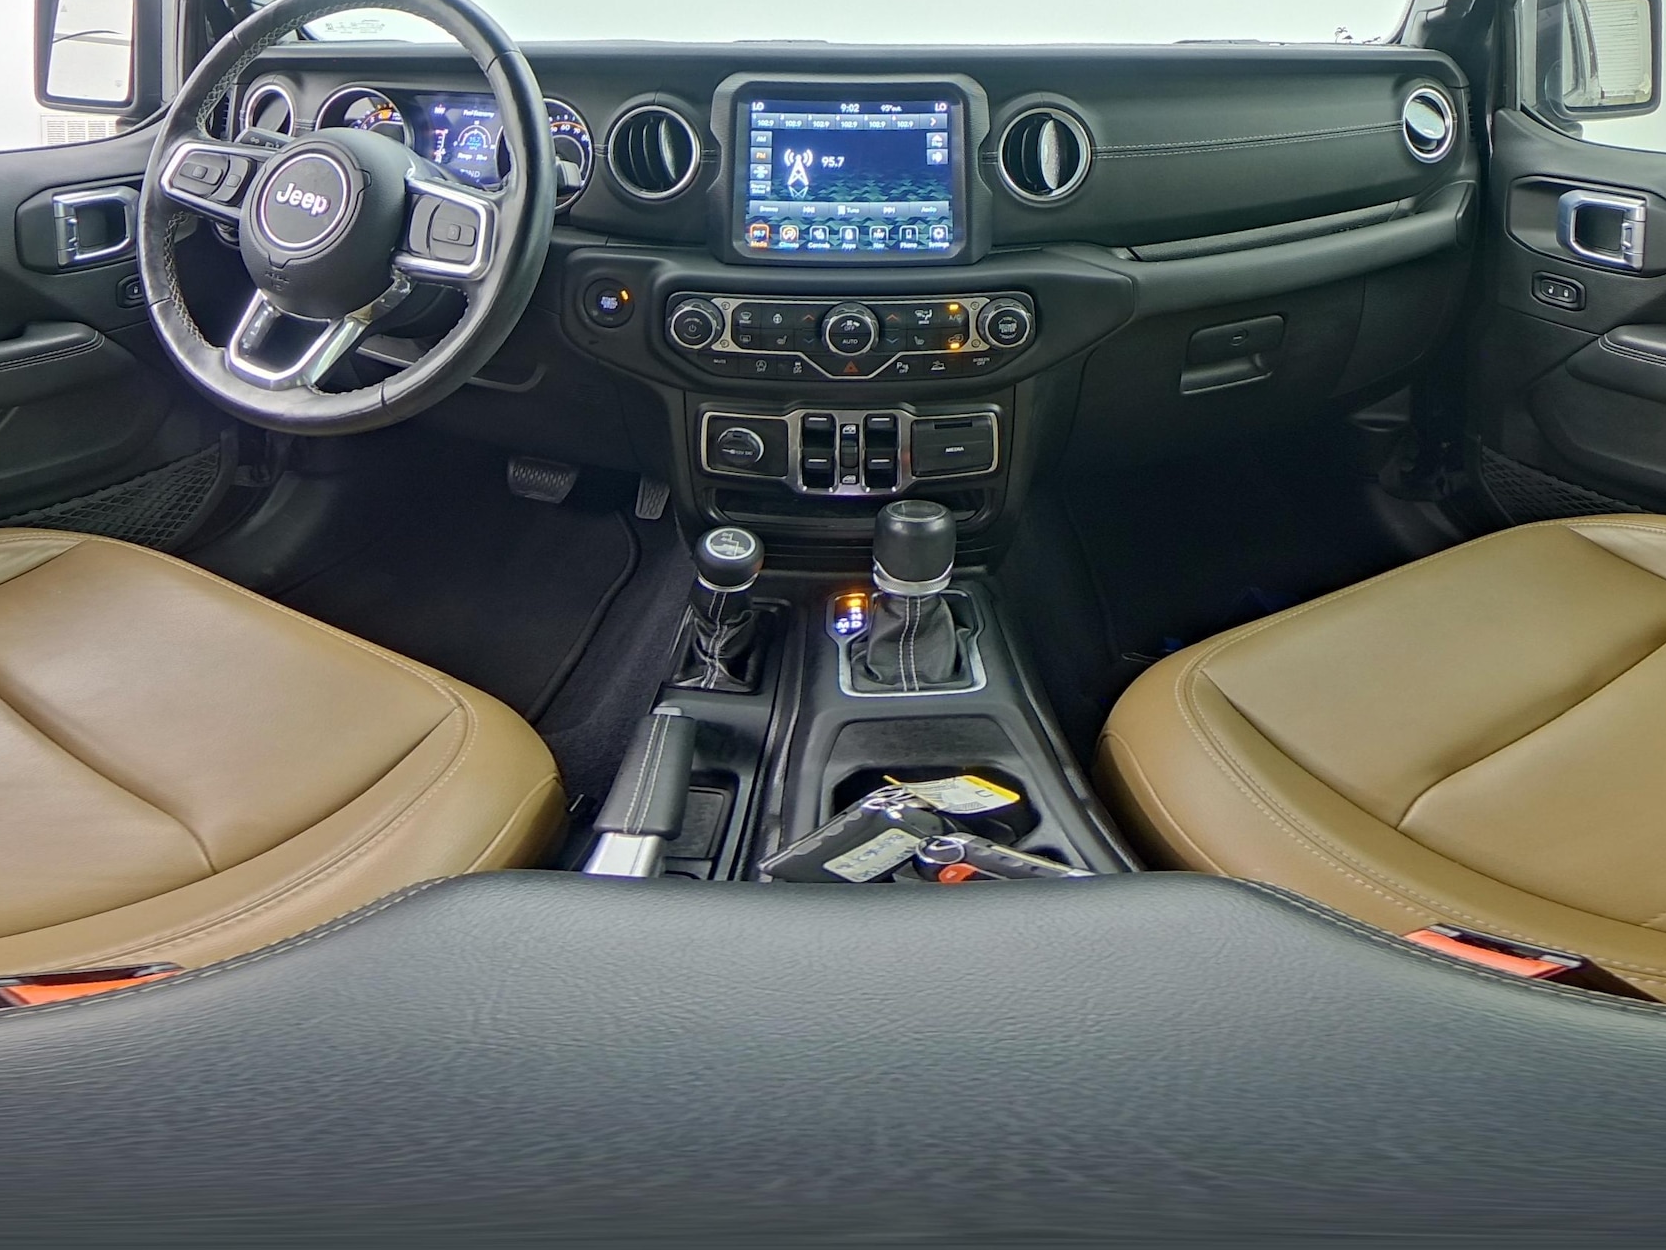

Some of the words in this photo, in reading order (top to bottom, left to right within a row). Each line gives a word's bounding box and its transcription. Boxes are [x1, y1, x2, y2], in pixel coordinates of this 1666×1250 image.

[751, 102, 765, 112] LO
[840, 103, 860, 113] 9:02
[934, 102, 948, 112] LO
[757, 119, 775, 127] 102.9
[785, 120, 803, 128] 102.9
[813, 120, 831, 128] 102.9
[821, 156, 845, 168] 95.7
[275, 182, 330, 216] Jeep
[750, 240, 768, 248] Media
[779, 241, 800, 249] Climate
[807, 241, 831, 249] Controls
[842, 242, 857, 251] Apps
[899, 242, 918, 250] Phone
[928, 241, 950, 250] Settings
